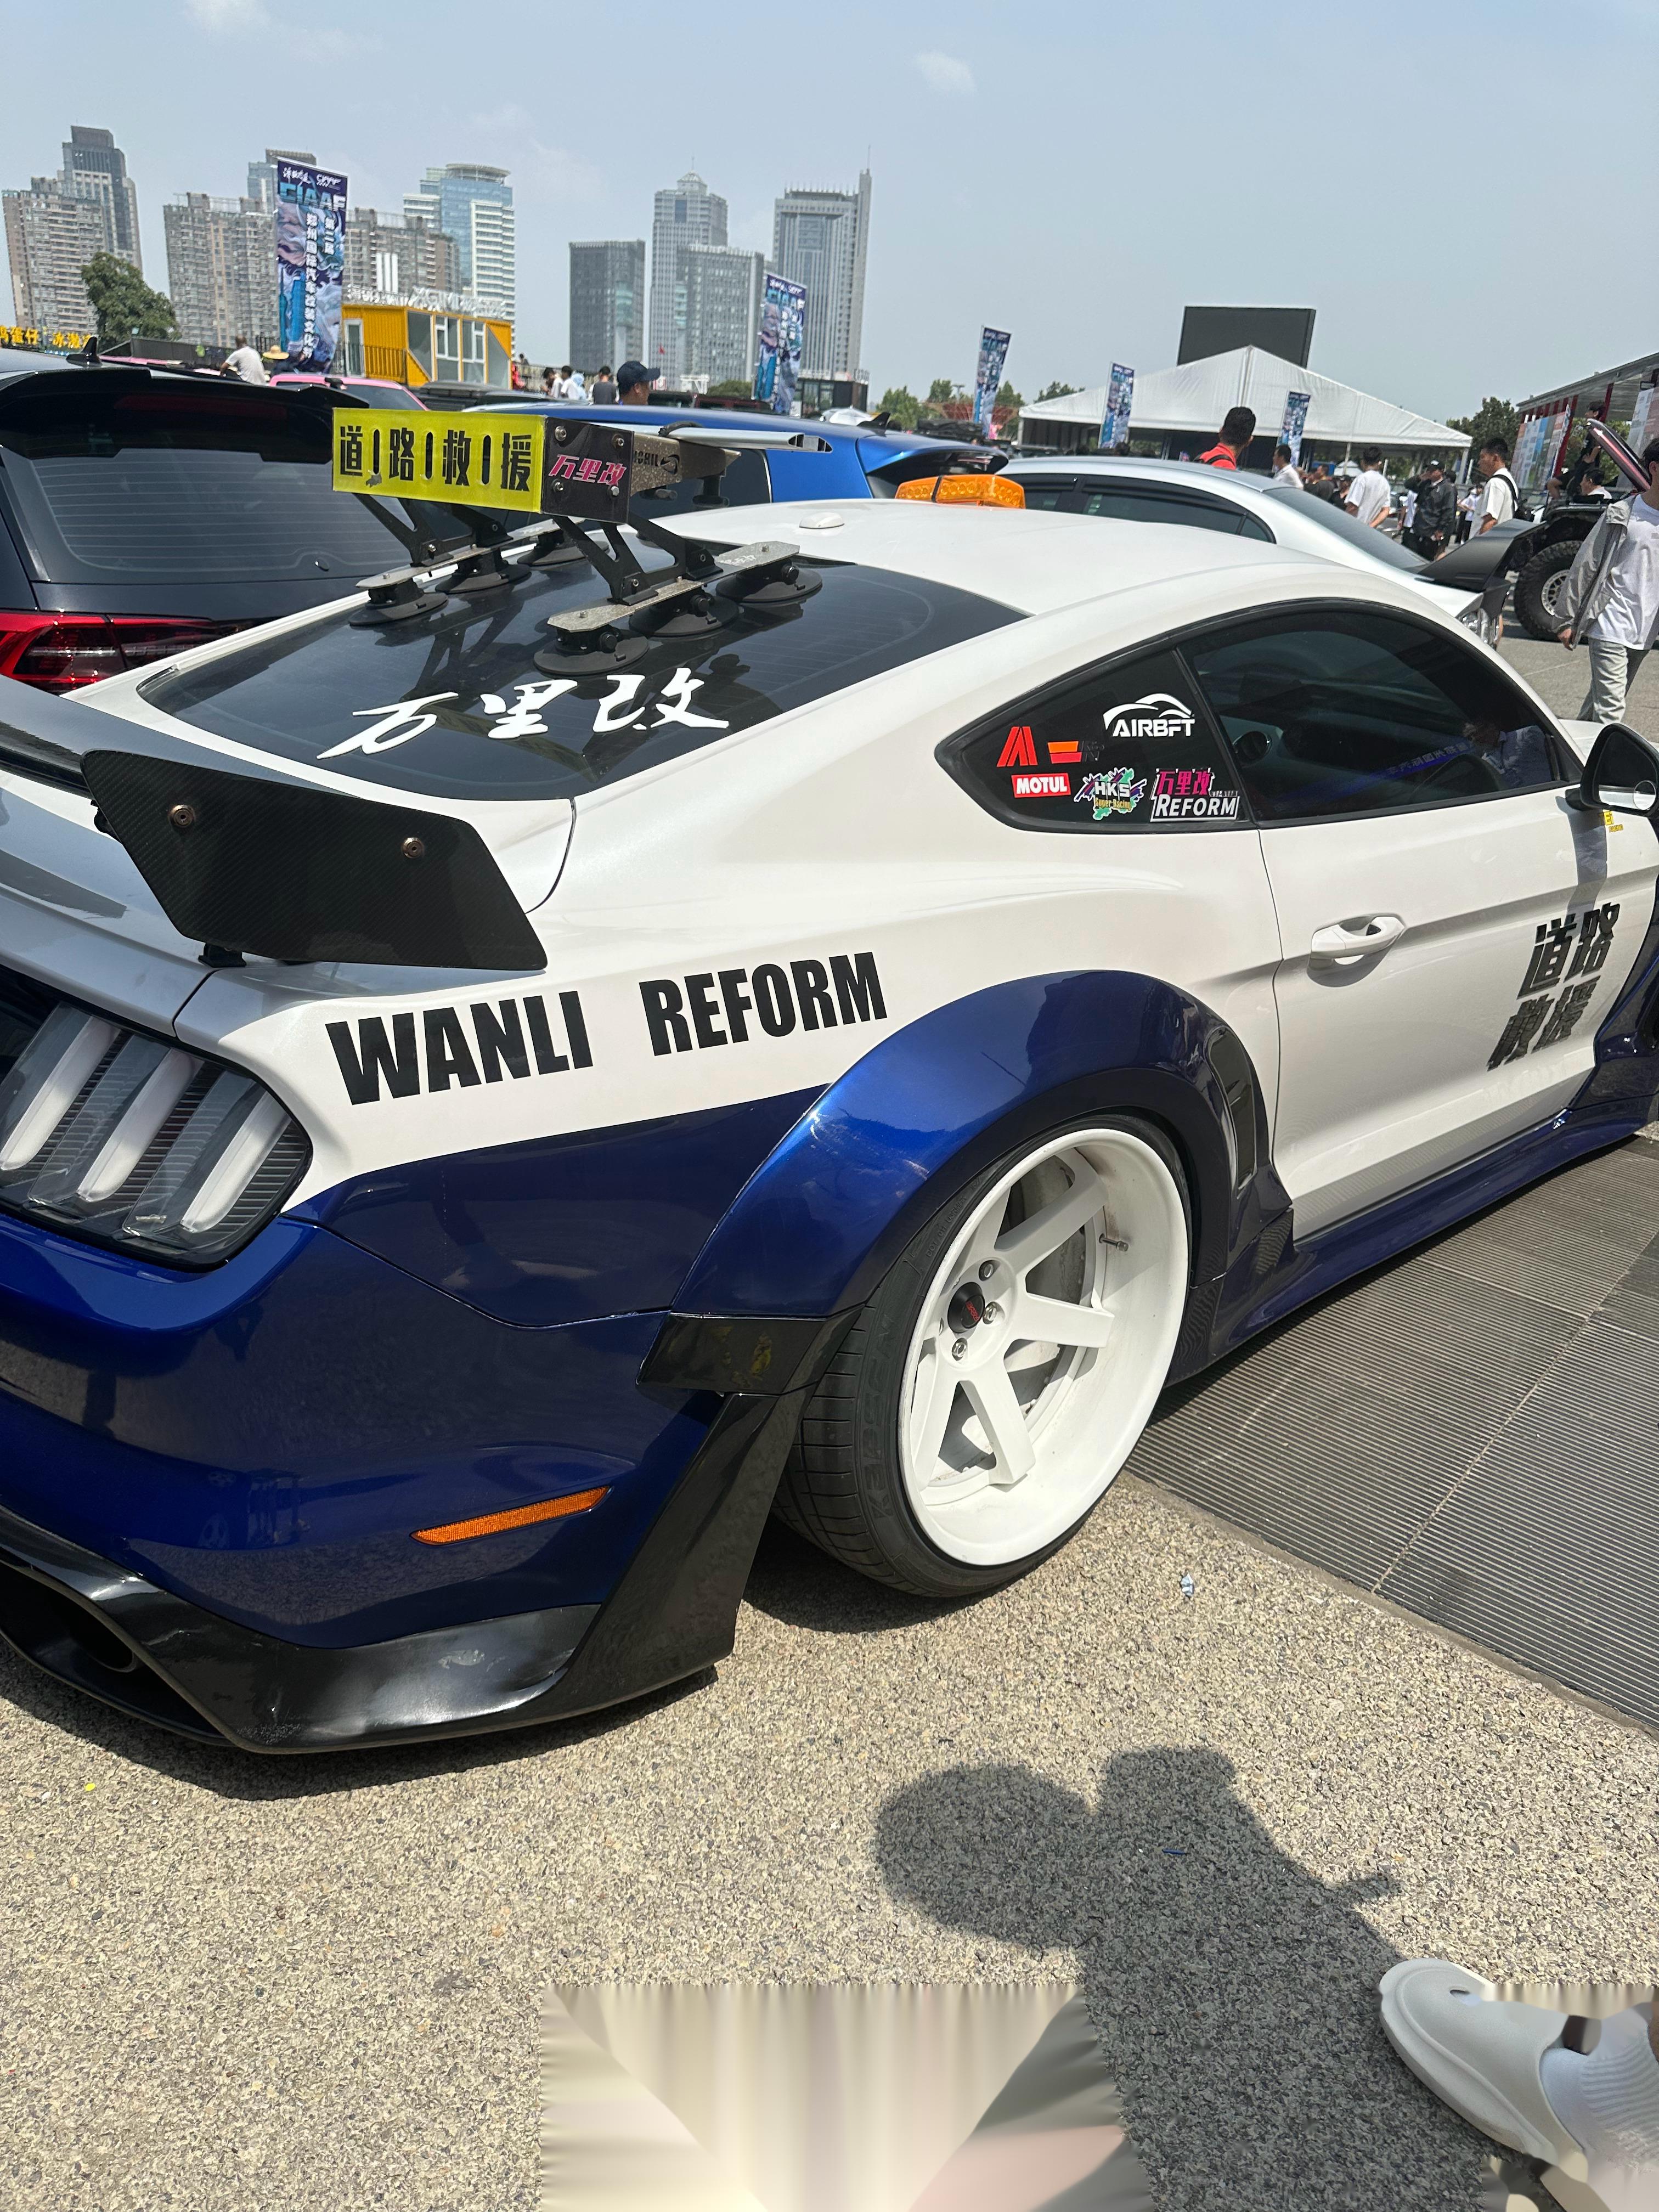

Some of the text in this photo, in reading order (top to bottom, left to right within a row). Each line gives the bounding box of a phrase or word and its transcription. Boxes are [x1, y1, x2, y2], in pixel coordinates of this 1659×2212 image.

[340, 425, 532, 492] 道路救援
[549, 454, 627, 486] 万里改
[317, 667, 729, 760] 万里改
[1113, 719, 1195, 737] AIRBFT
[1016, 776, 1068, 794] MOTUL
[1094, 781, 1130, 798] HKS
[1156, 770, 1211, 795] 万里改
[1154, 793, 1237, 817] REFORM
[1516, 902, 1620, 1000] 道路
[325, 951, 887, 1105] WANLI REFORM
[1486, 975, 1601, 1072] 救援
